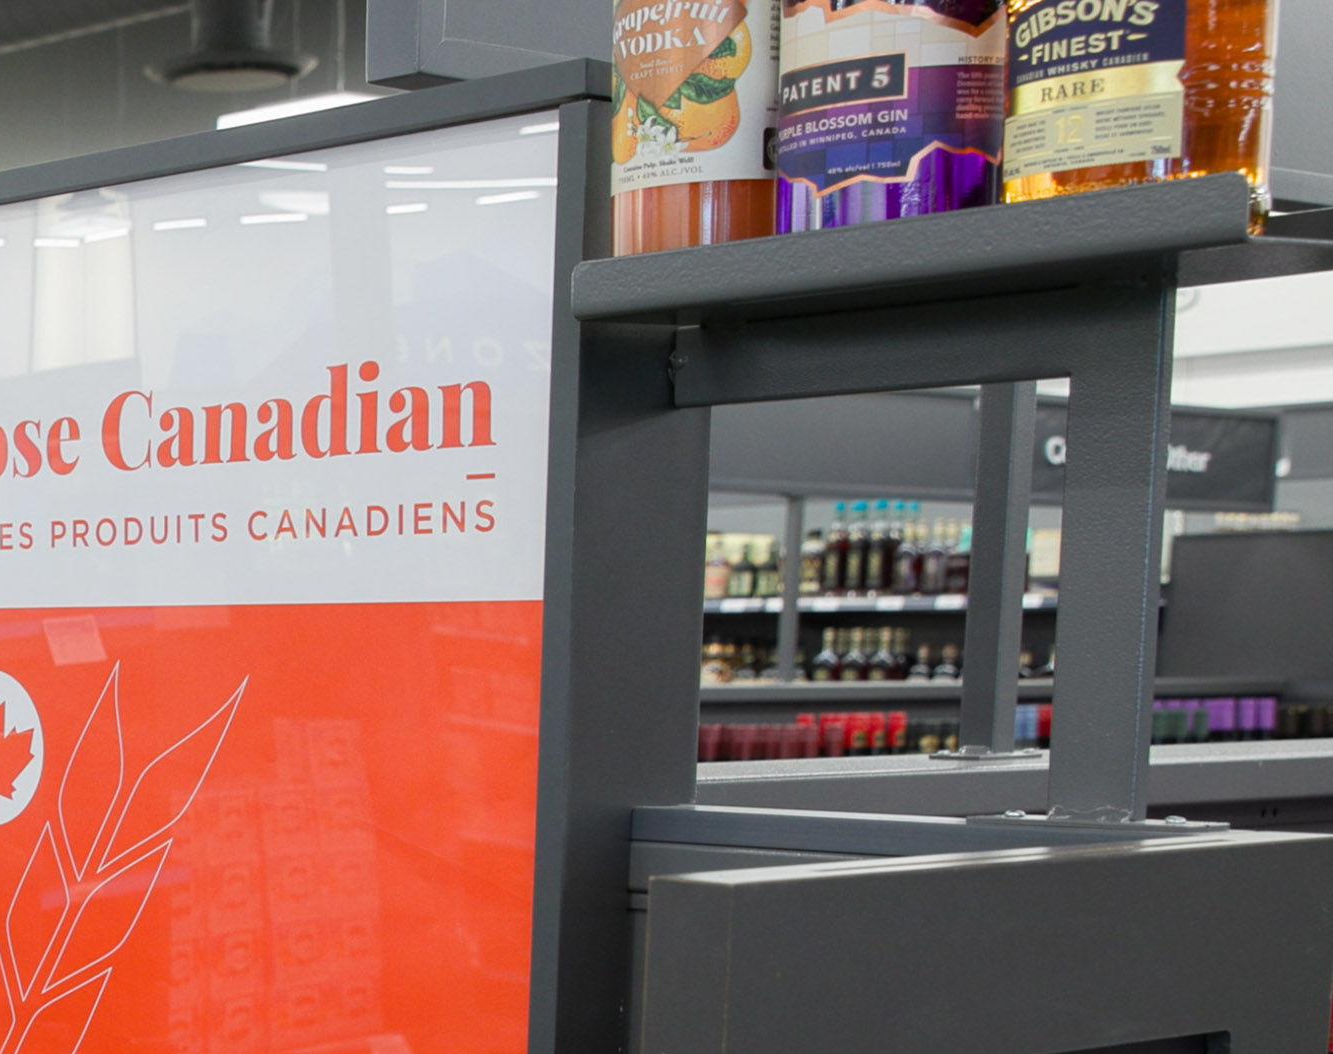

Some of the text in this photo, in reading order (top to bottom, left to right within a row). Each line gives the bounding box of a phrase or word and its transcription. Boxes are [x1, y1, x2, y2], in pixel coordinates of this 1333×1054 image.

[1015, 0, 1160, 48] GIBSON'S
[619, 26, 706, 59] VODKA
[1031, 30, 1124, 65] FINEST
[958, 56, 993, 64] HISTORY
[1048, 59, 1098, 76] WHISKY
[783, 65, 891, 105] PATENT 5
[1041, 78, 1105, 103] RARE
[805, 109, 908, 134] BLOSSOM GIN
[861, 126, 907, 138] CANADA
[1055, 115, 1083, 144] 12
[101, 360, 498, 472] Canadian
[50, 511, 229, 549] PRODUITS
[247, 499, 496, 541] CANADIENS
